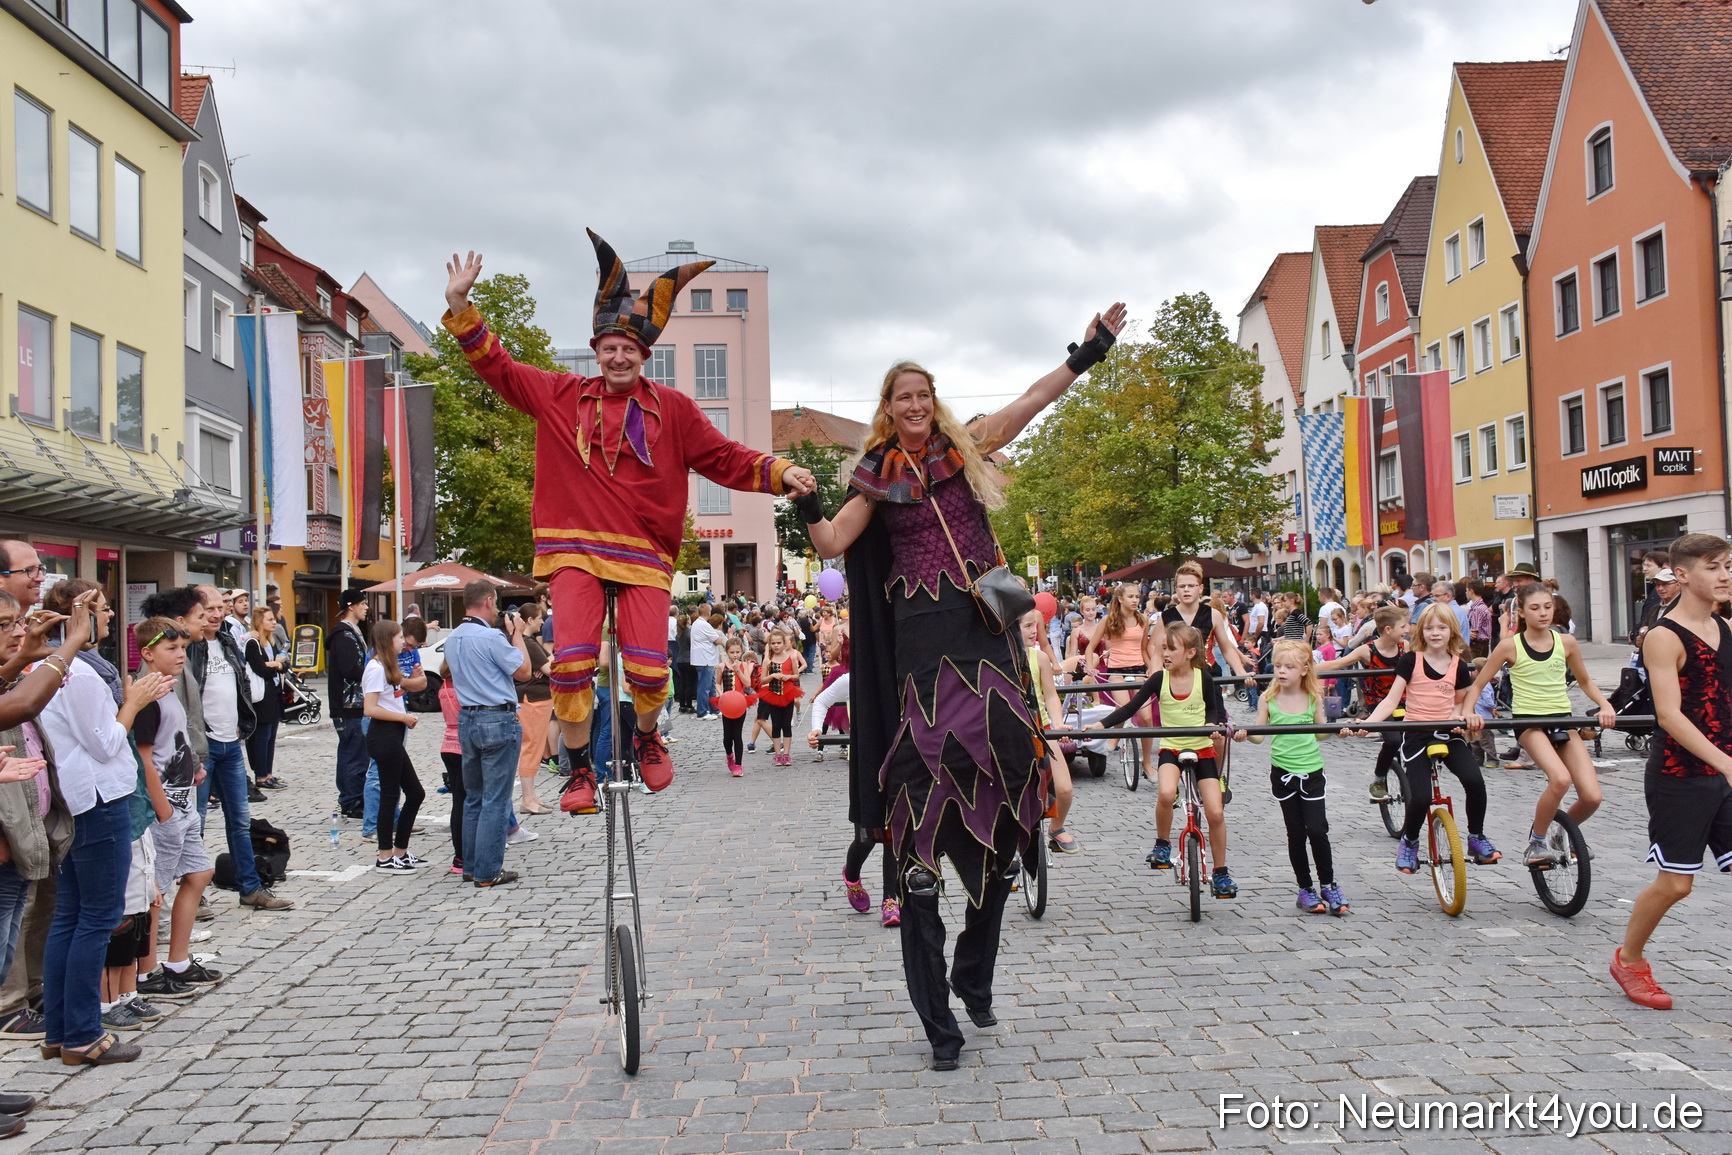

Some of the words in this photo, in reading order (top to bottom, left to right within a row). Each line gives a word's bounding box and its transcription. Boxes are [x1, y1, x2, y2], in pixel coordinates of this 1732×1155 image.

[1658, 450, 1692, 462] MATT
[1662, 463, 1688, 474] optik
[693, 526, 734, 538] rkasse
